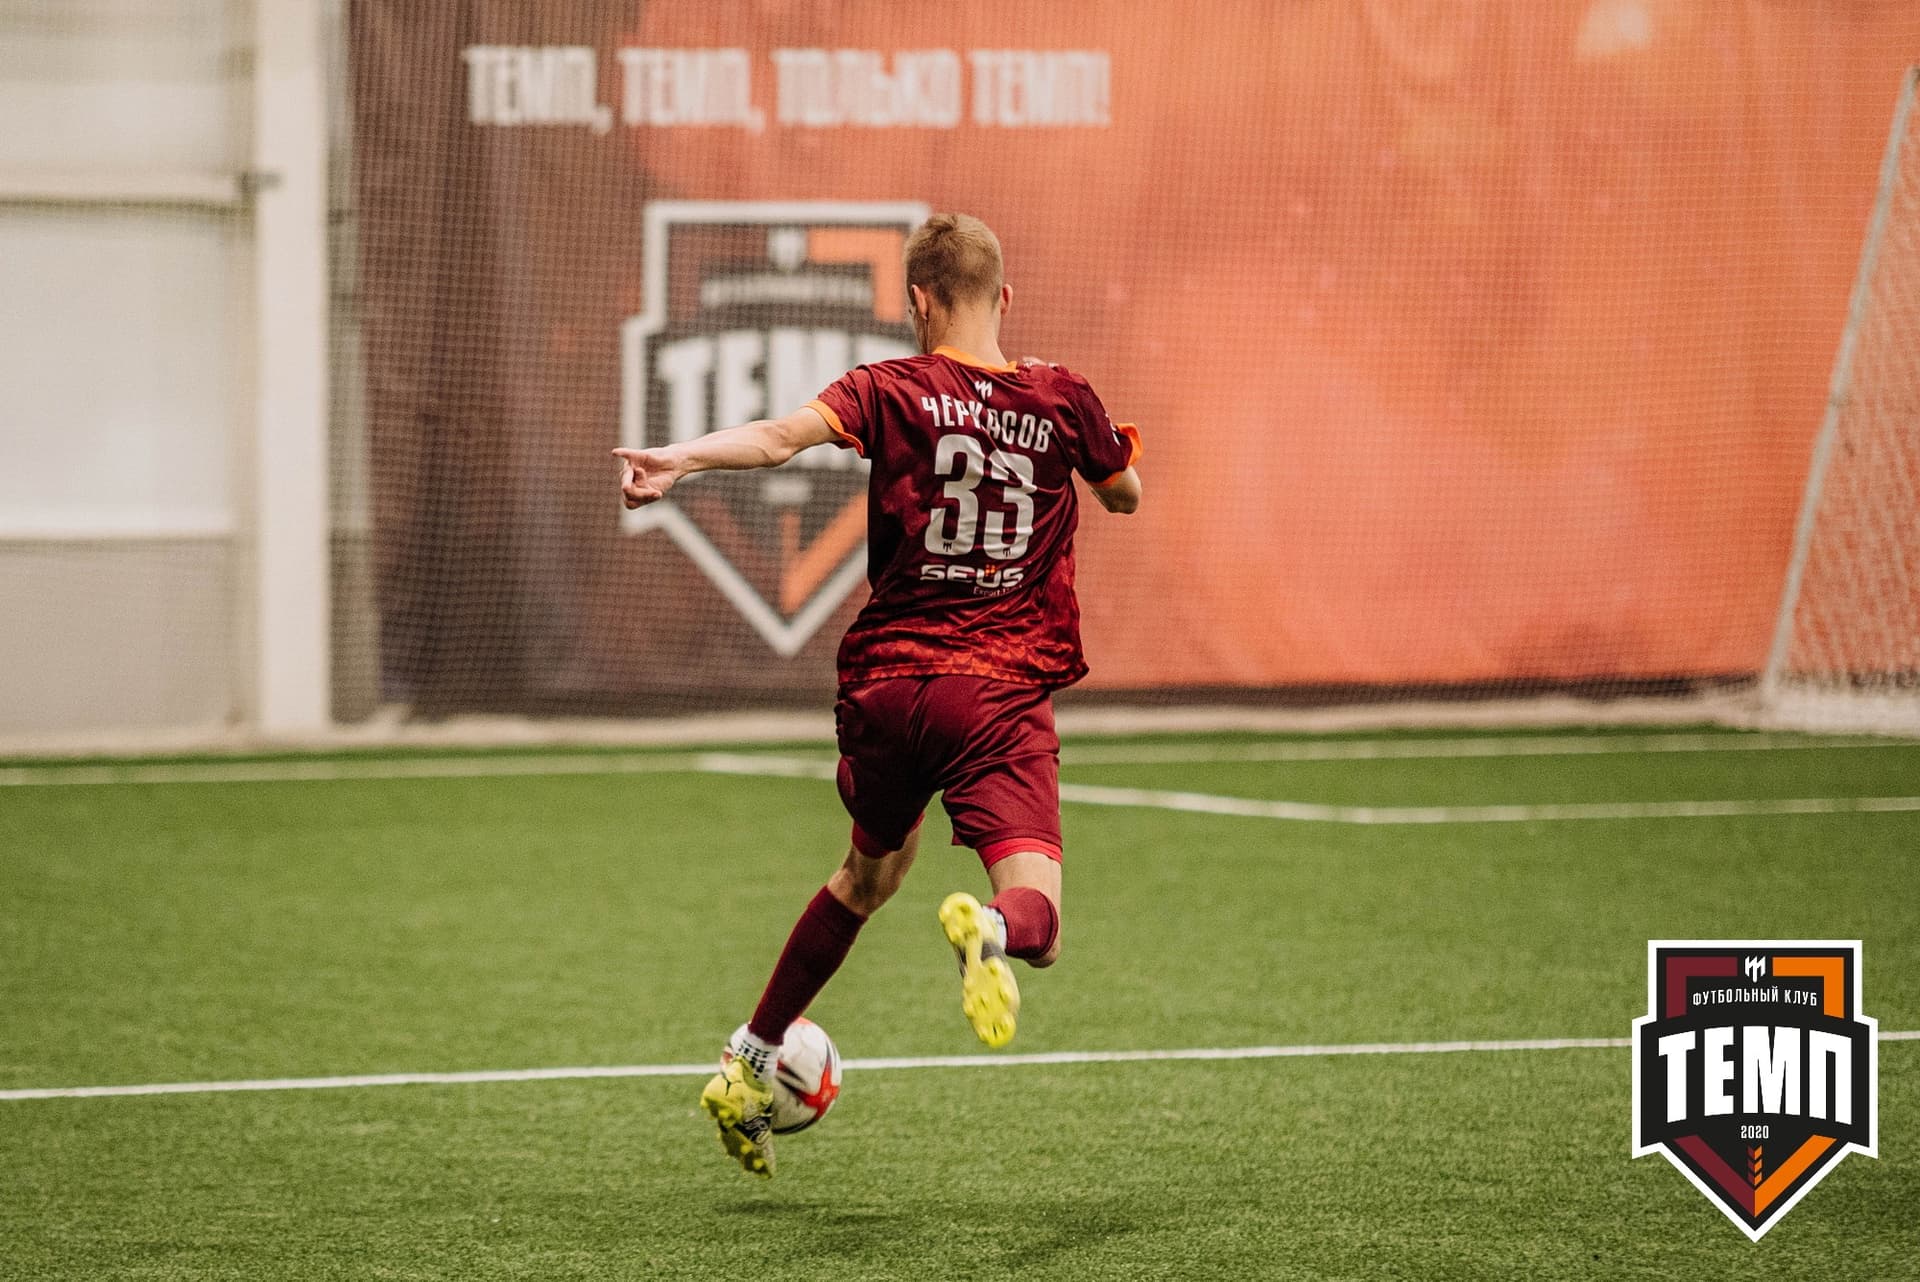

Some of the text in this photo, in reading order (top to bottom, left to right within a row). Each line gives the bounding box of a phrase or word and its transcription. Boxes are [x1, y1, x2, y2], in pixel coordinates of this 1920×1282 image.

[655, 328, 918, 472] ТЕМ
[921, 393, 1053, 453] ЧЕРКАСОВ
[924, 433, 1037, 560] 33
